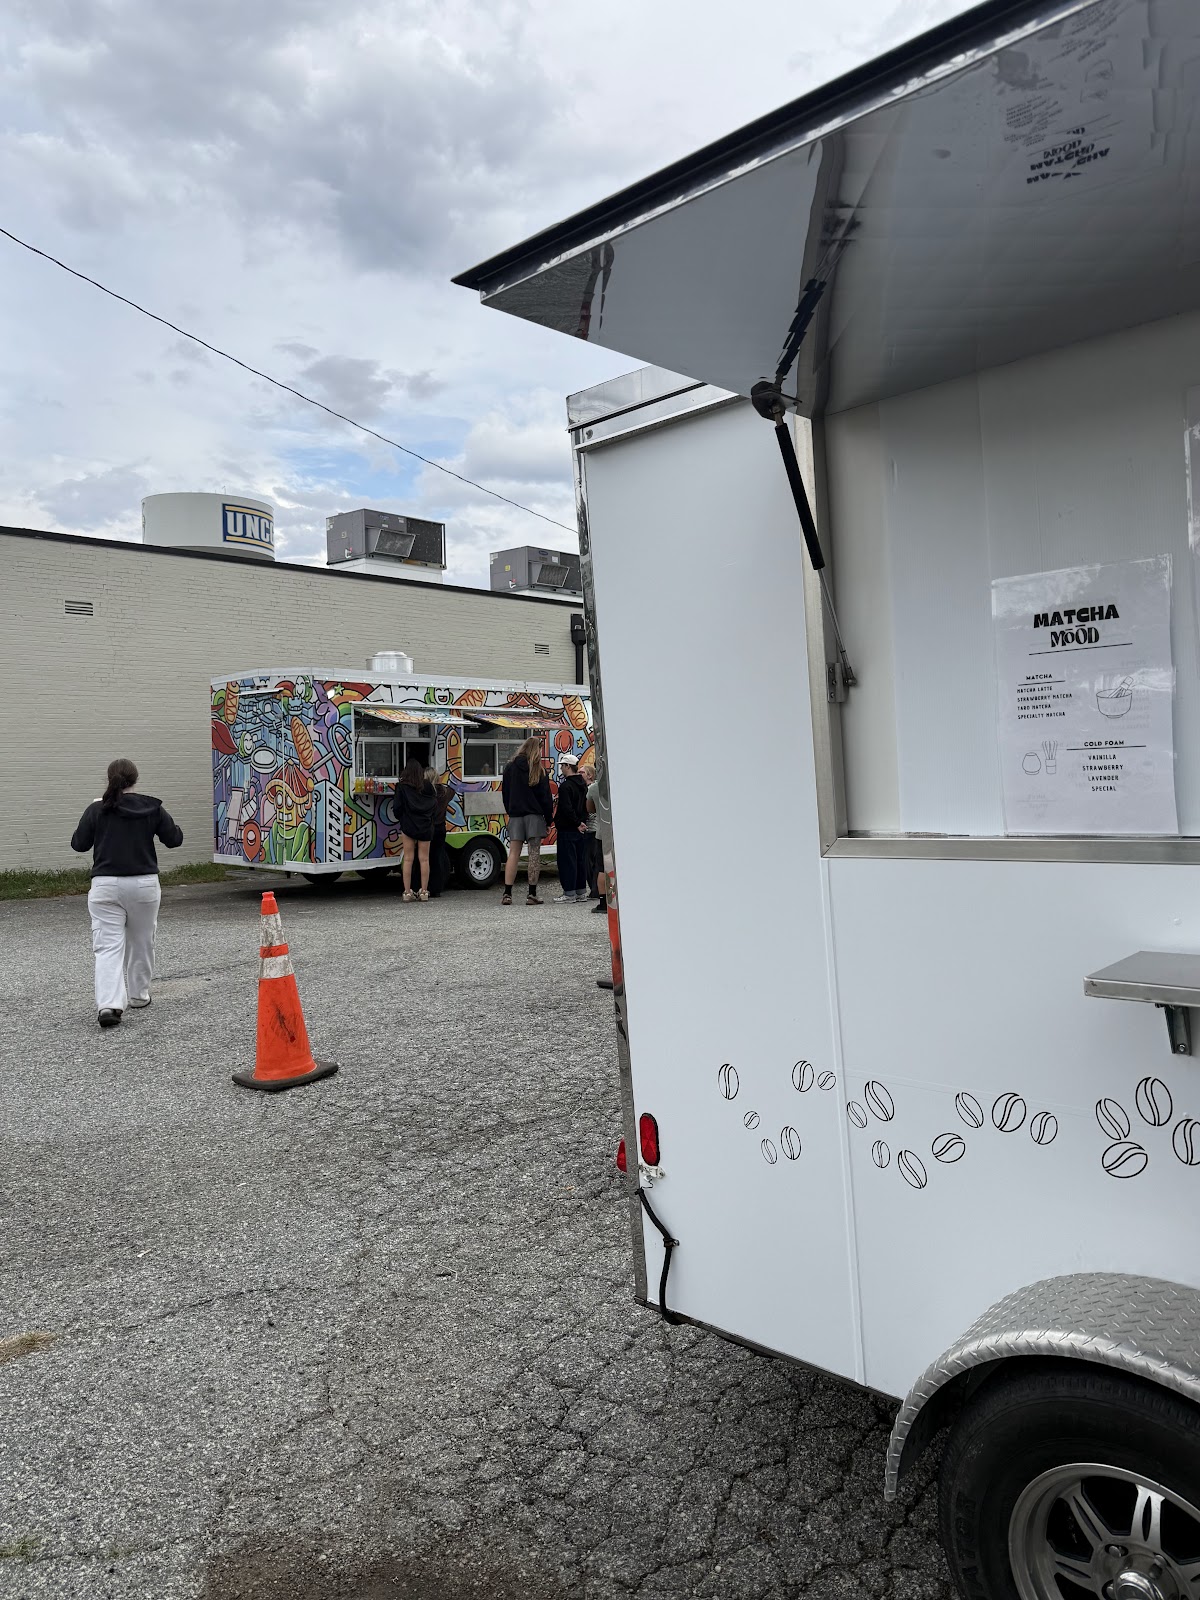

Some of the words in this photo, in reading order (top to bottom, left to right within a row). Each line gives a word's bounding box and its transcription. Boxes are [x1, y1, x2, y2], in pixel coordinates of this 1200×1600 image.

[1033, 604, 1120, 628] MATCHA
[1025, 673, 1053, 681] MATCHA
[1017, 695, 1051, 703] STRAWBERRY
[328, 786, 342, 863] CORNDO
